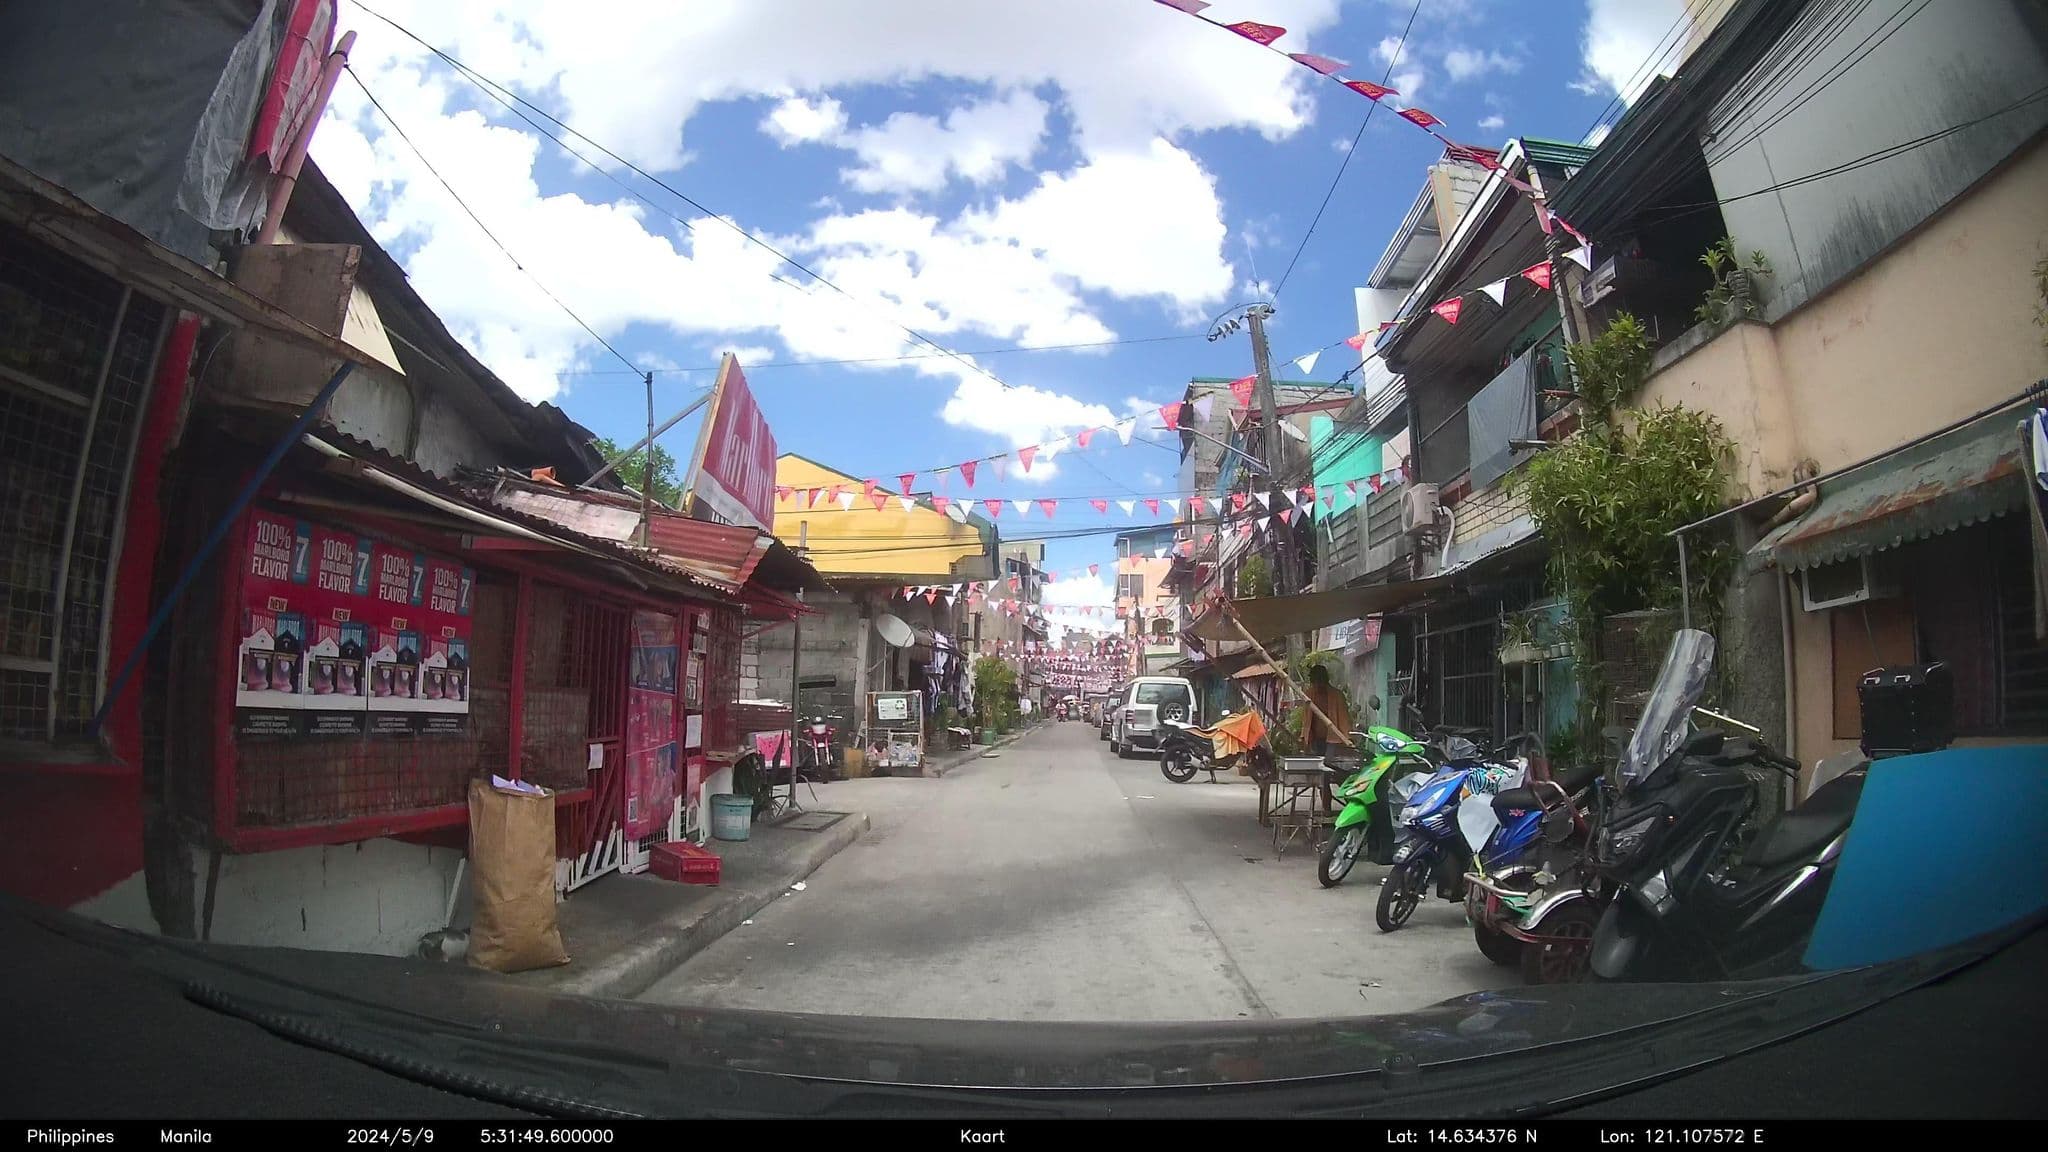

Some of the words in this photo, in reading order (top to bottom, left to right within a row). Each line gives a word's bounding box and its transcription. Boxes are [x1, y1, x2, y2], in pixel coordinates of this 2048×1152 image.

[257, 520, 291, 549] 100%
[254, 542, 290, 562] MARLBORO
[323, 538, 353, 564] 100%
[252, 556, 289, 581] FLAVOR
[320, 559, 352, 576] MARLBORO
[382, 553, 410, 577] 100%
[318, 571, 351, 594] FLAVOR
[434, 568, 458, 589] 100%
[269, 597, 287, 611] NEW
[379, 583, 407, 604] FLAVOR
[334, 609, 350, 621] NEW
[430, 595, 456, 614] FLAVOR
